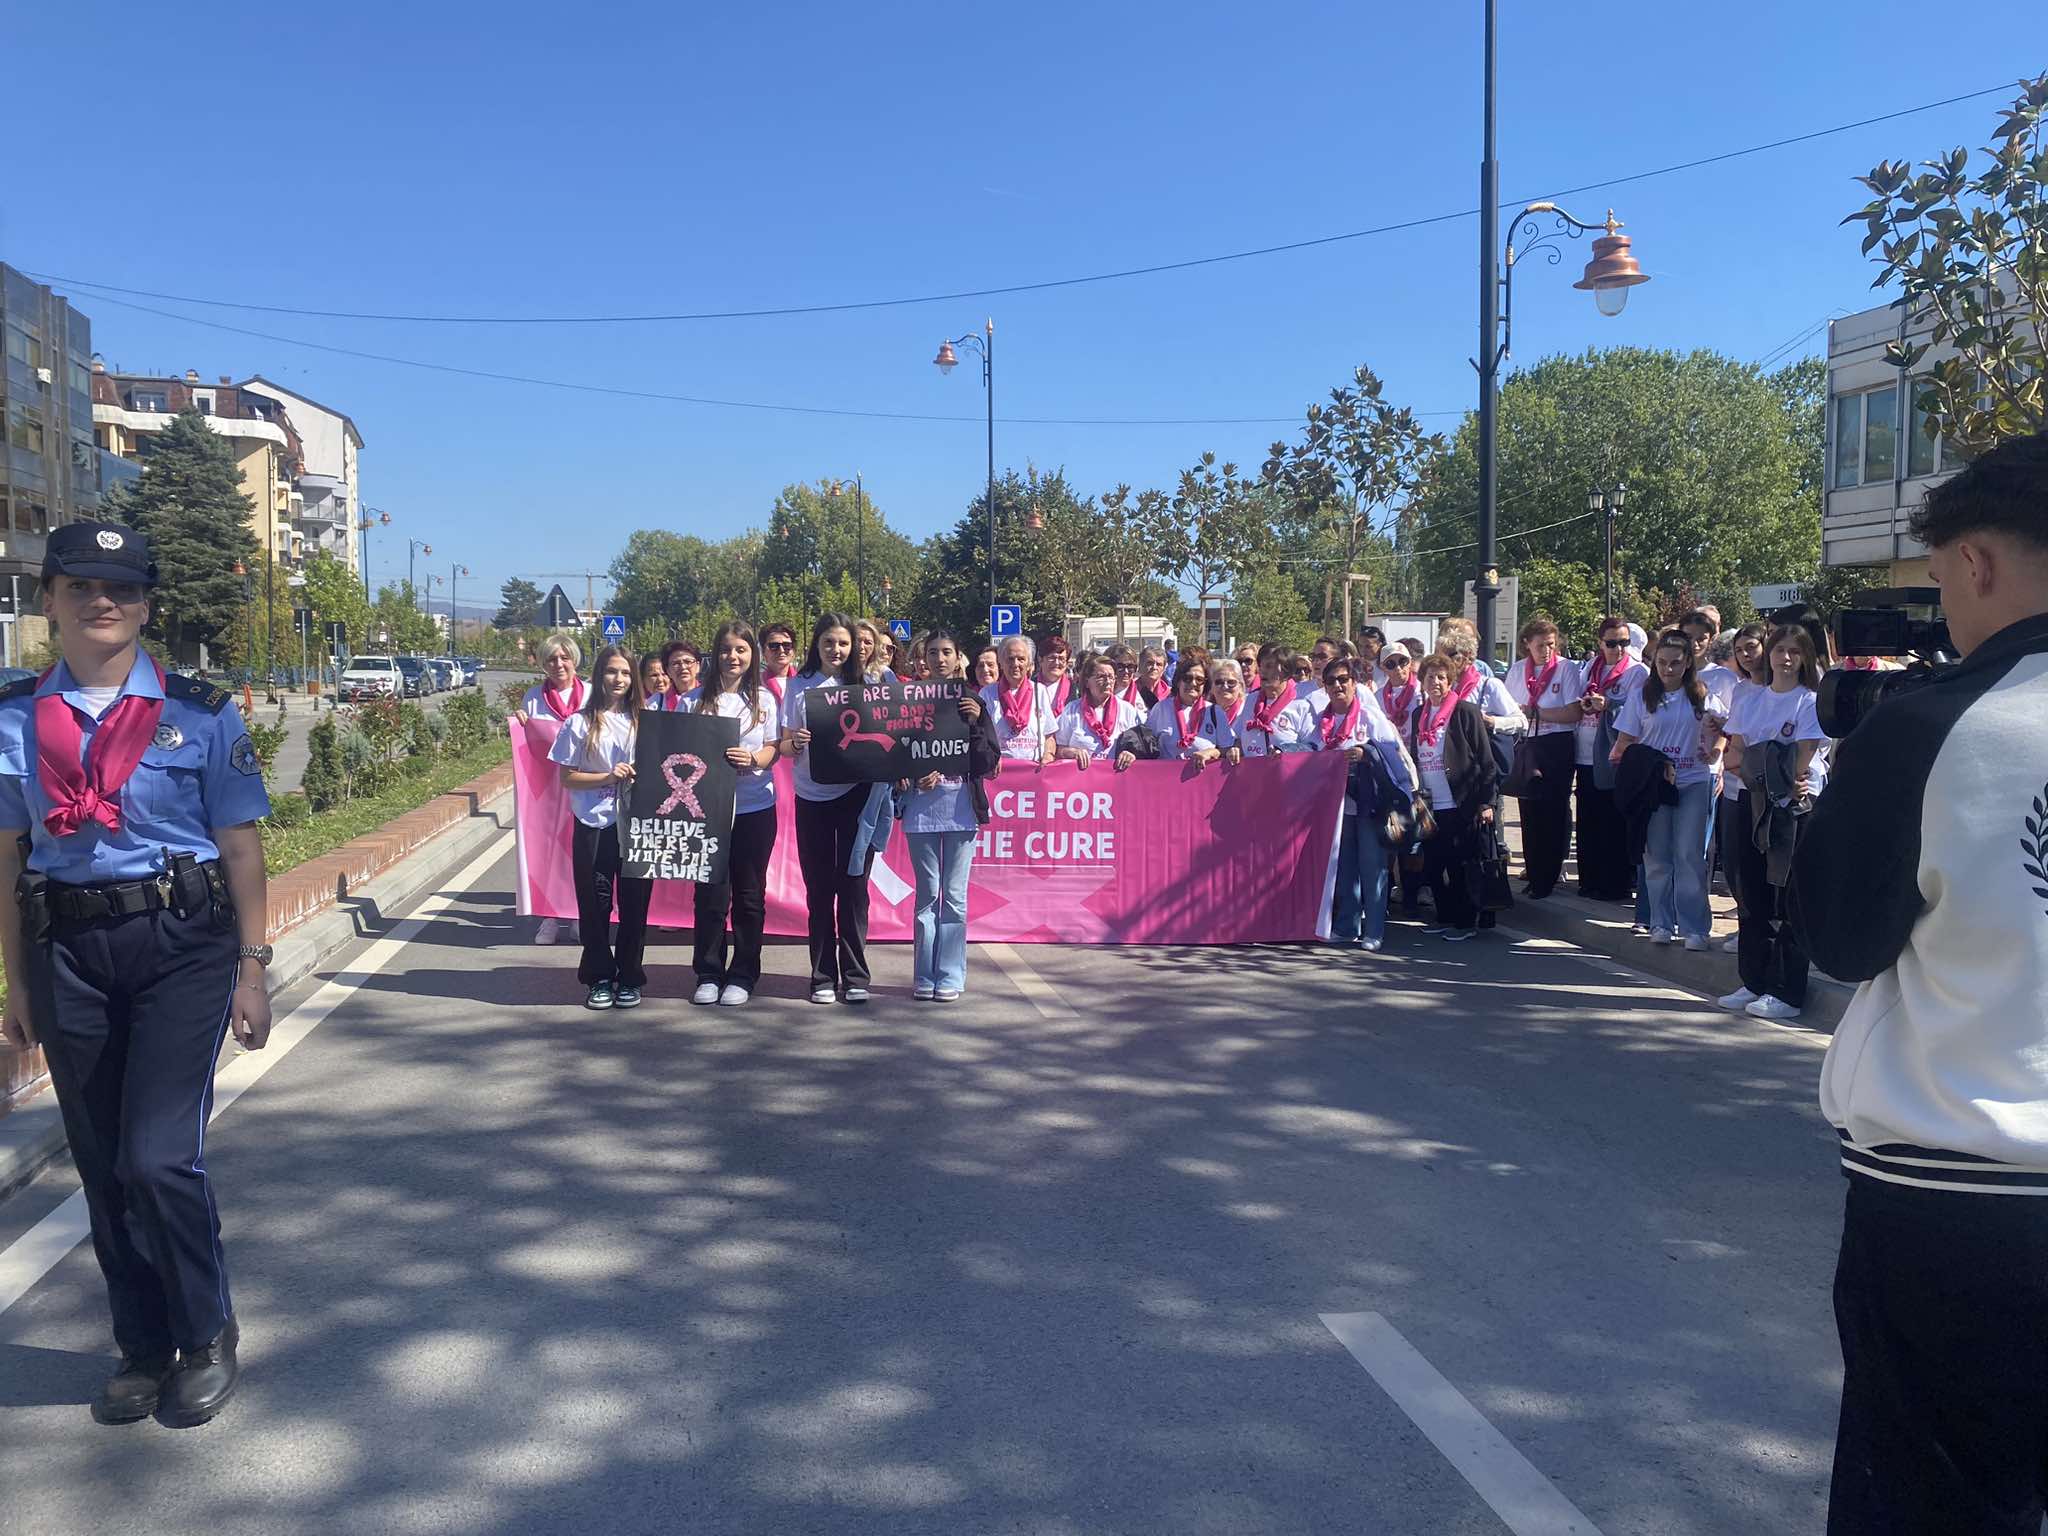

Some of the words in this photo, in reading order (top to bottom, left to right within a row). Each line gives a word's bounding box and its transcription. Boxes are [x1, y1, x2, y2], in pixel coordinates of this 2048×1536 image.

[998, 609, 1014, 633] P
[824, 690, 849, 705] WE
[863, 686, 891, 703] ARE
[903, 684, 963, 700] FAMILY
[872, 705, 889, 720] NO
[911, 739, 965, 759] ALONE
[986, 790, 1036, 819] CE
[1047, 791, 1114, 820] FOR
[630, 817, 706, 839] BELIEVE
[630, 833, 690, 853] THERE
[700, 837, 719, 855] IS
[1024, 831, 1116, 860] CURE
[627, 848, 675, 865] HOPE
[642, 863, 658, 879] A
[660, 863, 712, 883] CURE
